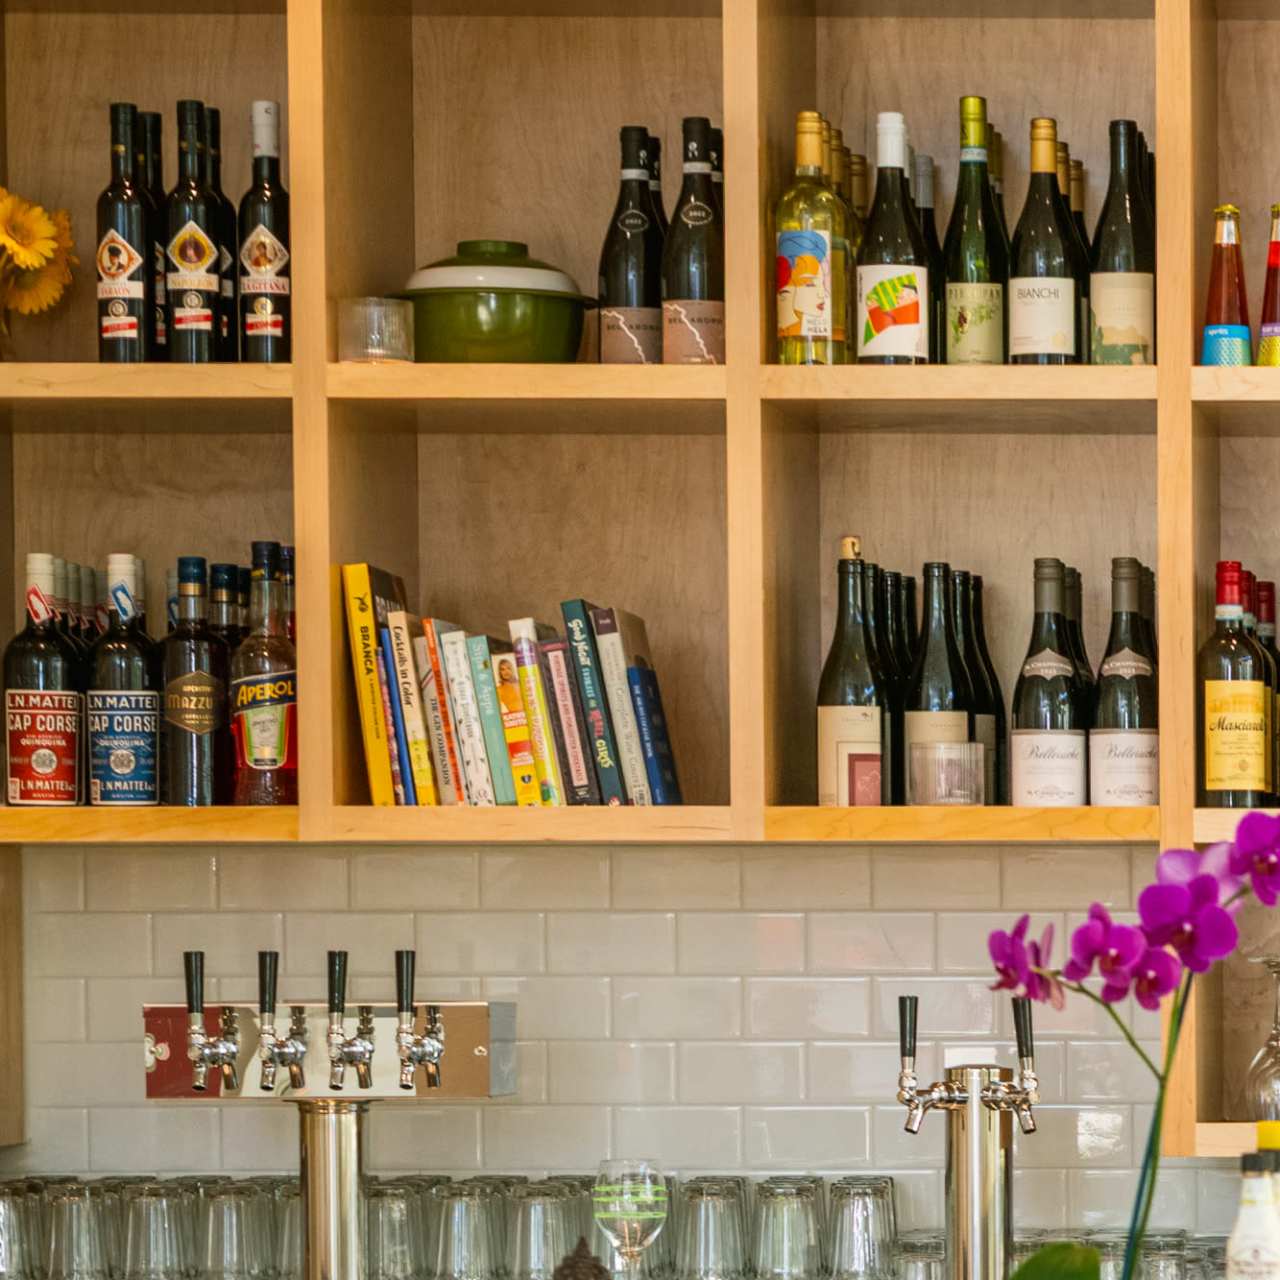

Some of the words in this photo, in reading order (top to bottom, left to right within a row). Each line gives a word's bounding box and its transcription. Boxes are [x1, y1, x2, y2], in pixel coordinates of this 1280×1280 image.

[1017, 287, 1060, 299] BIANCHI
[360, 625, 374, 676] BRANCA
[393, 625, 409, 668] Cocktails
[401, 681, 414, 708] Color
[237, 681, 295, 707] APEROL
[8, 714, 32, 731] CAP
[36, 714, 77, 732] CORSE
[88, 715, 109, 732] CAP
[114, 715, 157, 732] CORSE
[20, 738, 67, 746] QUINQUINA
